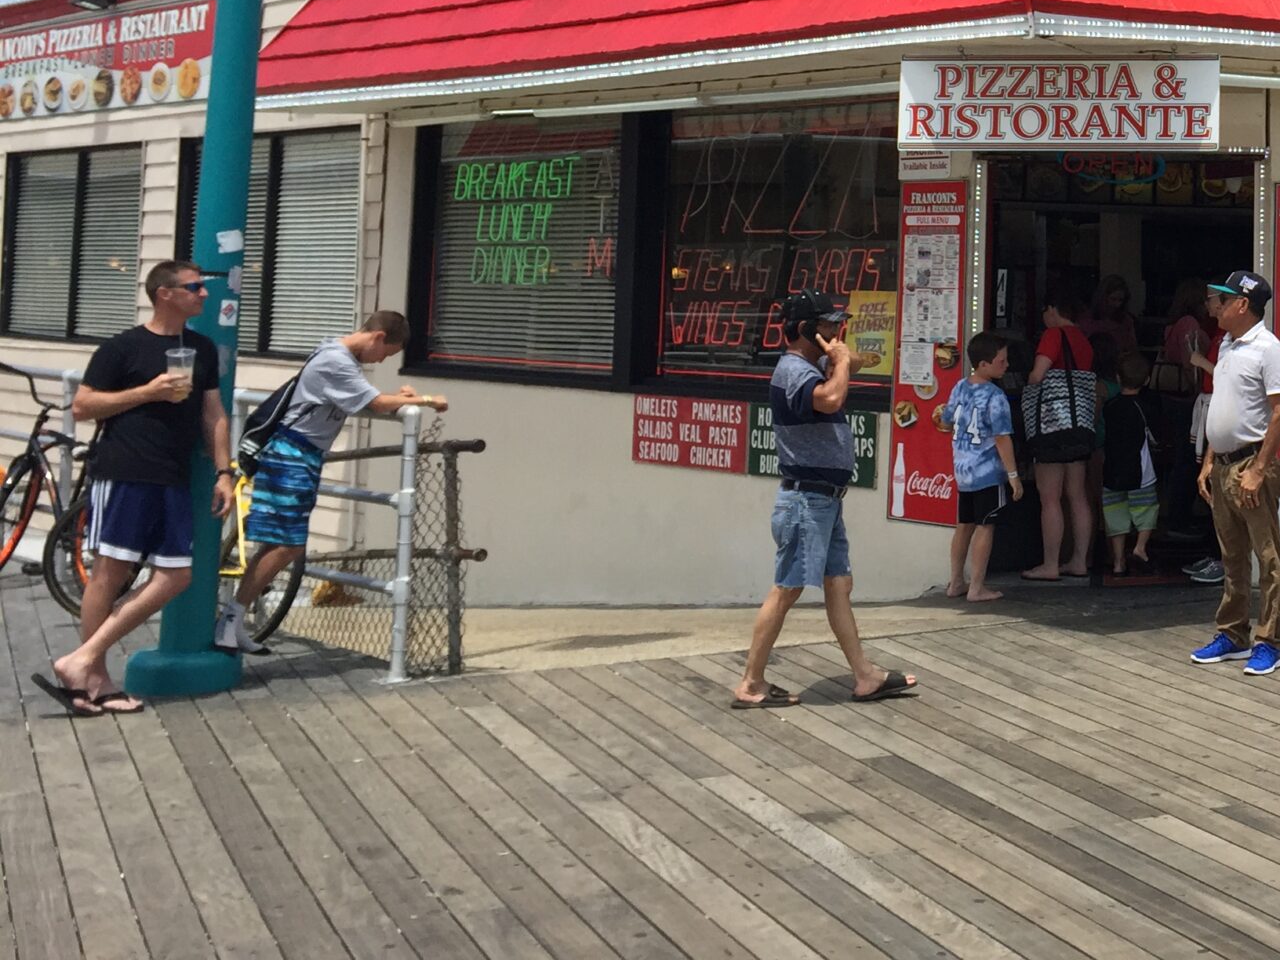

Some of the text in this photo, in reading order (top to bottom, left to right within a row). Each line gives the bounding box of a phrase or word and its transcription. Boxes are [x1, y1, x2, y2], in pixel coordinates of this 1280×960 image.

[47, 23, 103, 54] PIZZERIA
[106, 20, 116, 44] &
[119, 4, 209, 43] RESTAURANT
[123, 38, 175, 65] DINNER
[934, 63, 1186, 101] PIZZERIA &
[905, 103, 1212, 141] RISTORANTE
[454, 156, 581, 200] BREAKFAST
[1062, 150, 1154, 174] OPEN
[911, 192, 957, 204] FRANCONI'S
[476, 202, 553, 241] LUNCH
[470, 245, 551, 286] DINNER
[788, 248, 885, 295] GYROS
[669, 301, 751, 346] WINGS
[637, 398, 678, 419] OMELETS
[692, 401, 742, 425] PANCAKES
[638, 419, 738, 447] SALADS VEAL PASTA
[638, 441, 732, 469] SEAFOOD CHICKEN
